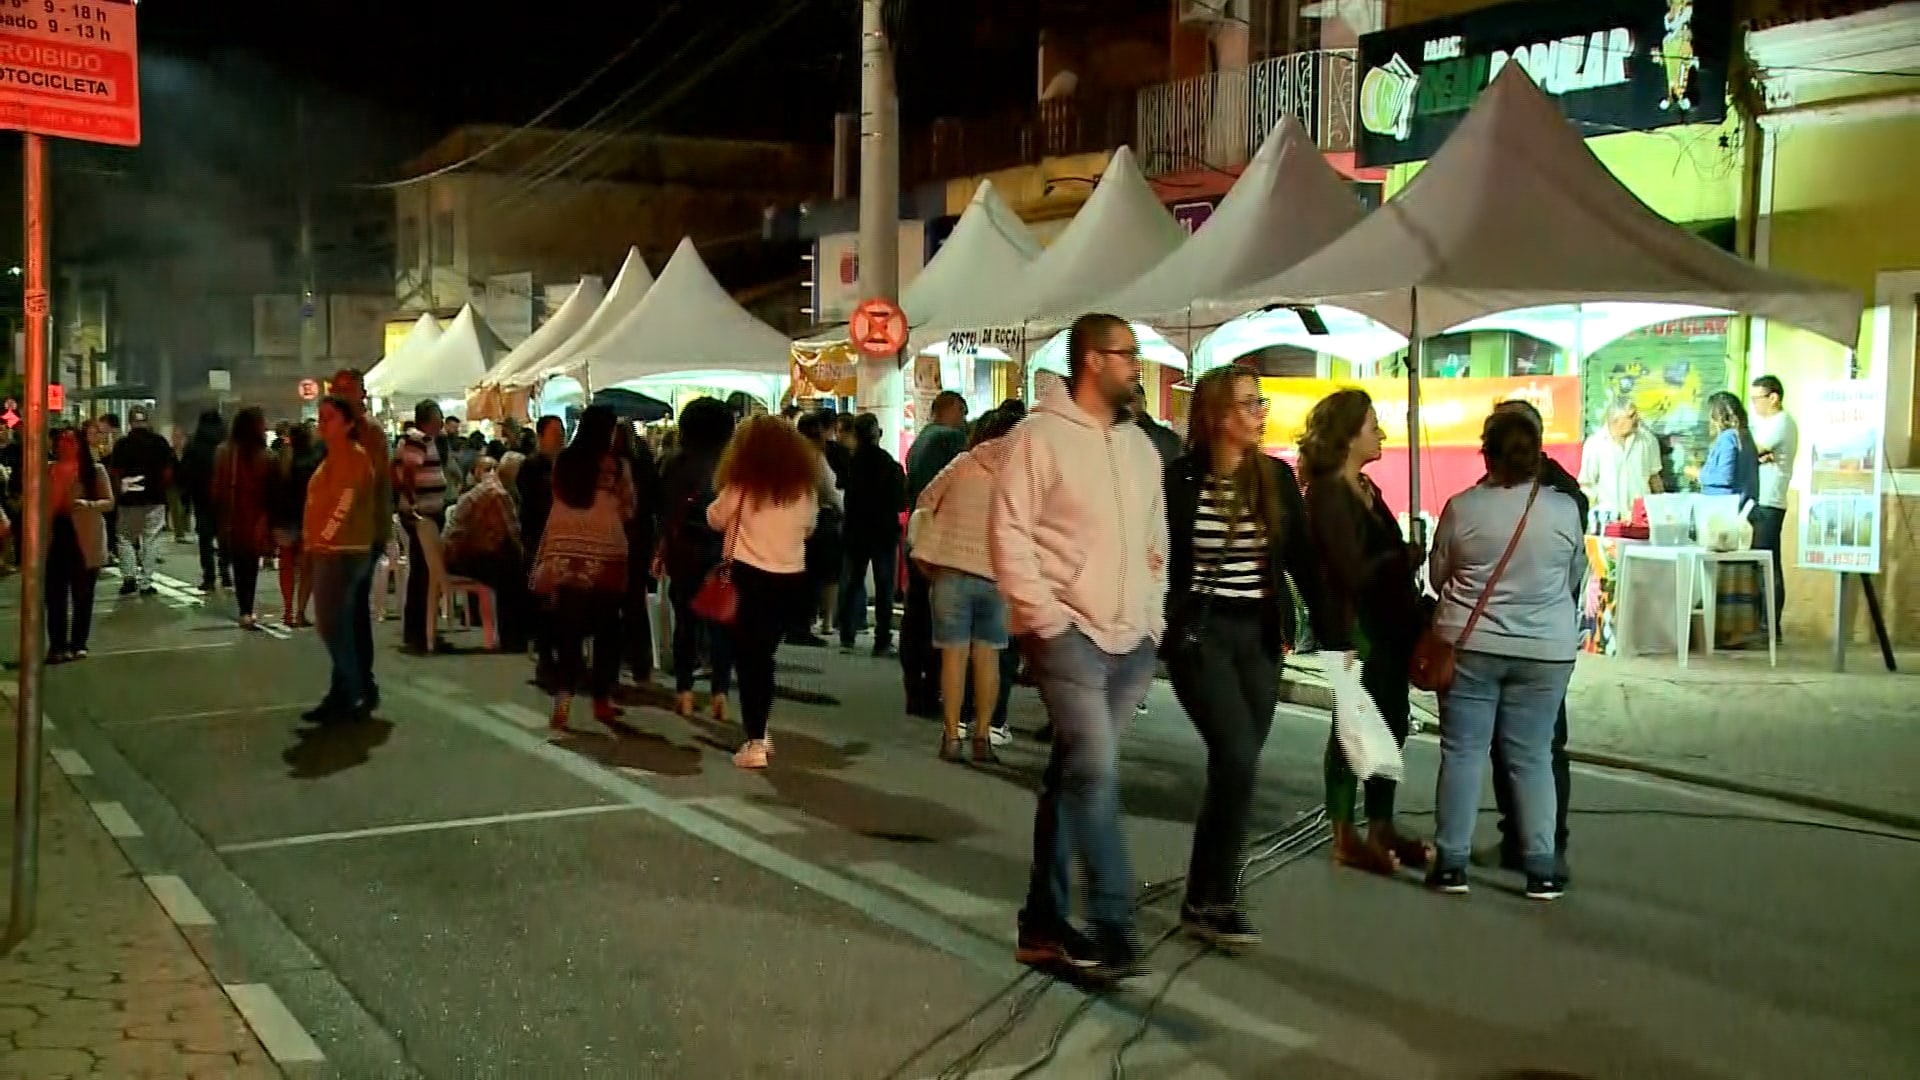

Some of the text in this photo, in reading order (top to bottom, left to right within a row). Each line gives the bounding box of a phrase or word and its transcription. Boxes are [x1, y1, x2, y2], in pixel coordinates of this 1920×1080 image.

[44, 0, 54, 13] 9
[73, 4, 90, 19] 18
[97, 8, 106, 22] h
[48, 19, 58, 33] 9
[76, 24, 94, 38] 13
[100, 27, 110, 41] h
